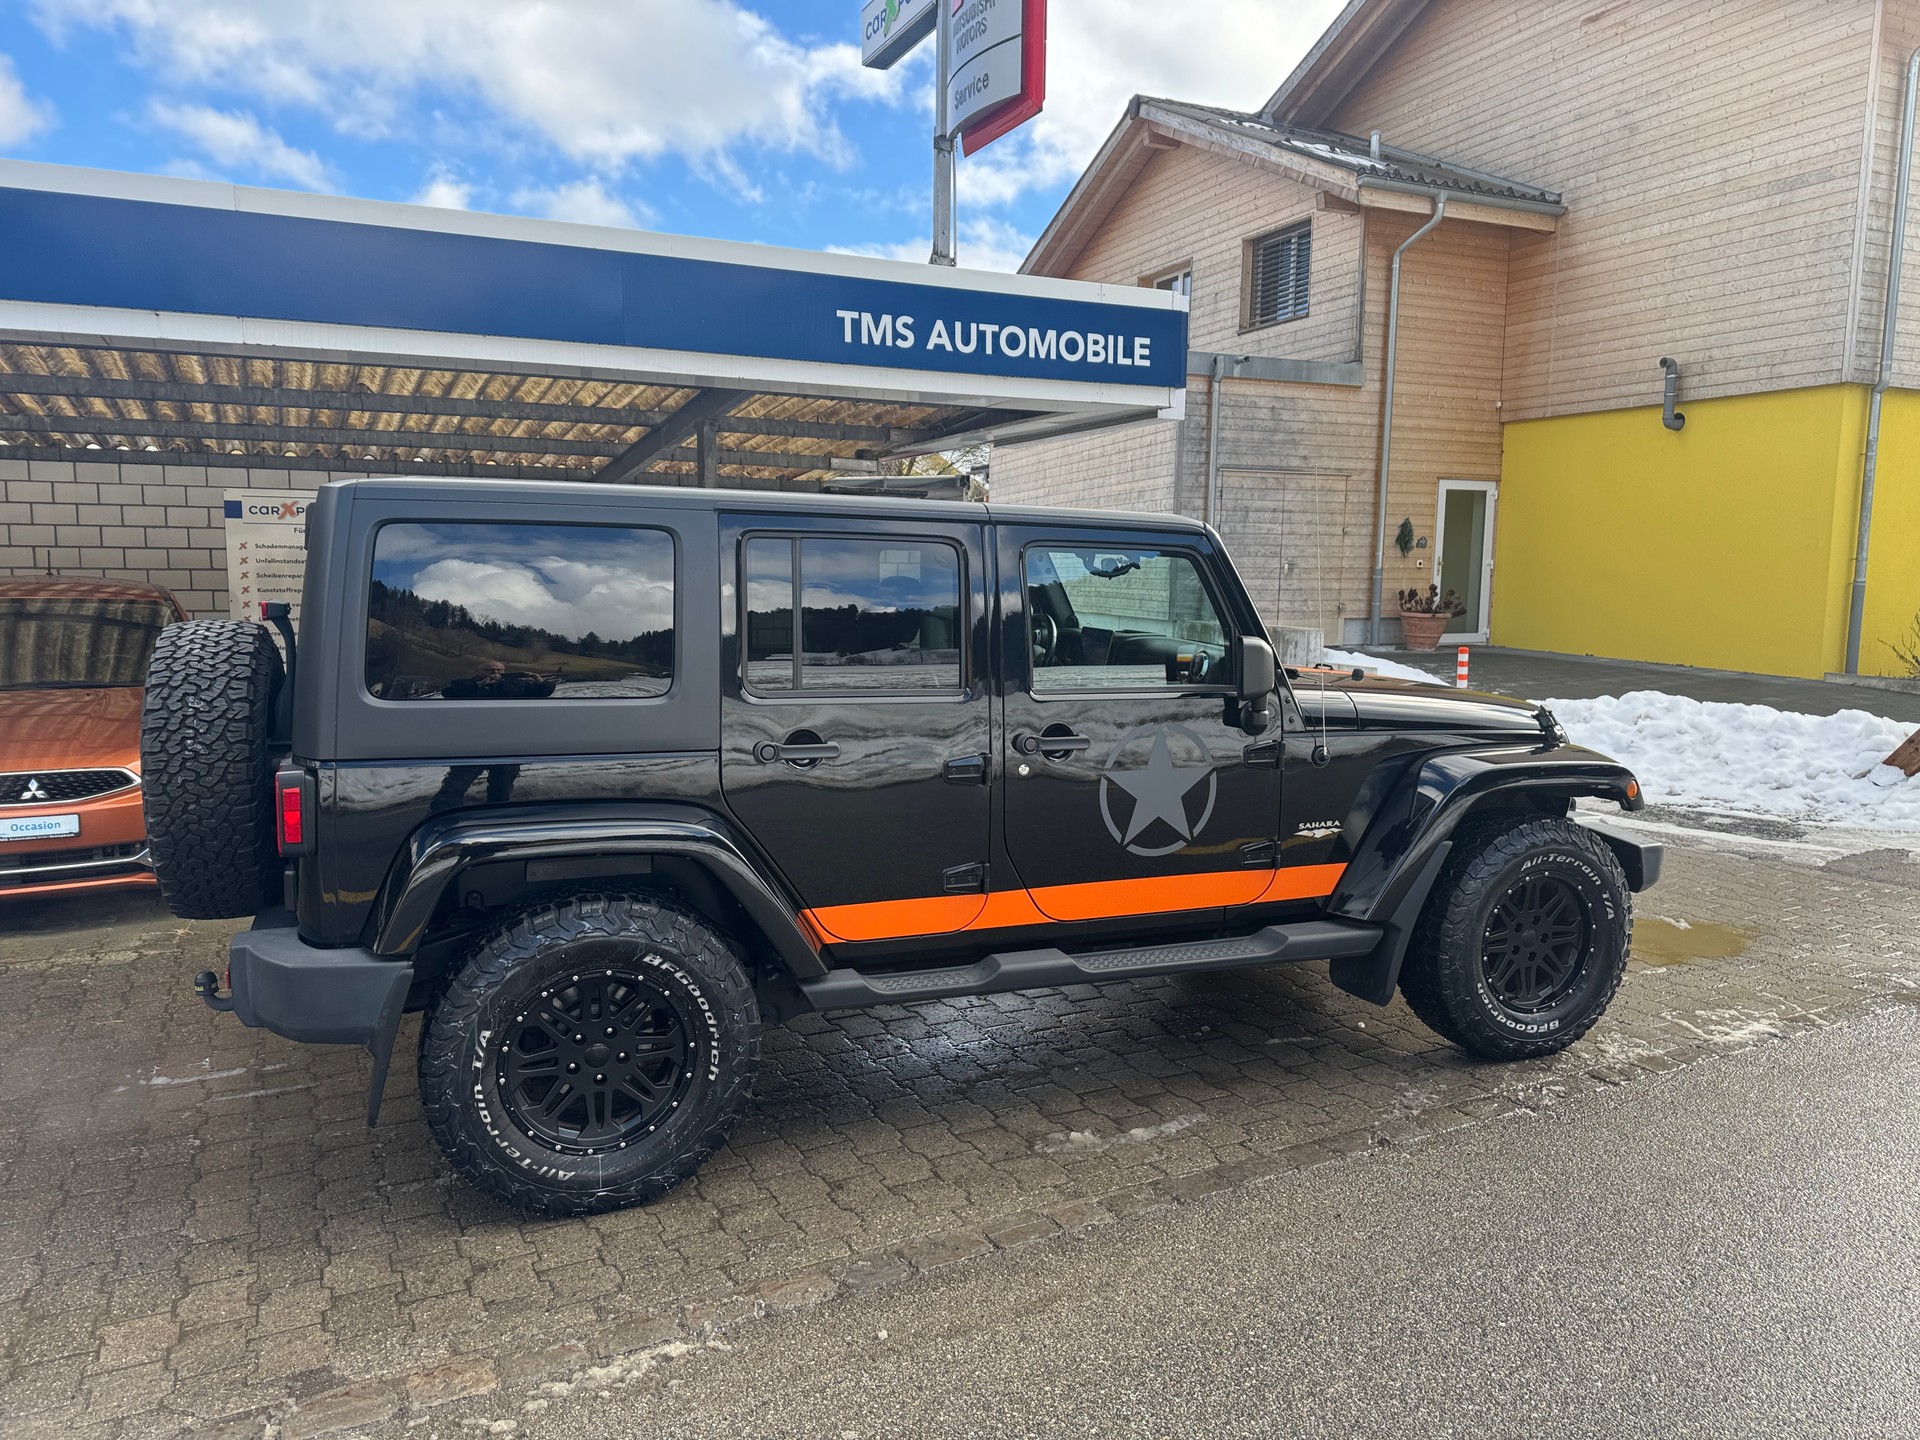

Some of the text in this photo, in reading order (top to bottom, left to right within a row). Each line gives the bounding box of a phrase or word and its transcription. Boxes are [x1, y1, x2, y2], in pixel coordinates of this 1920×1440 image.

[956, 16, 988, 54] MOTORS
[954, 72, 990, 110] Service
[836, 309, 1151, 367] TMS AUTOMOBILE
[256, 572, 304, 580] Scheibenrepar
[10, 821, 61, 832] Occasion
[1298, 819, 1341, 830] SAHARA
[1520, 853, 1615, 920] All-Terrain T/A
[642, 952, 721, 1081] BFGoodrich
[1477, 982, 1560, 1034] BFGoodrich
[471, 1029, 577, 1182] All-Terrain T/A
